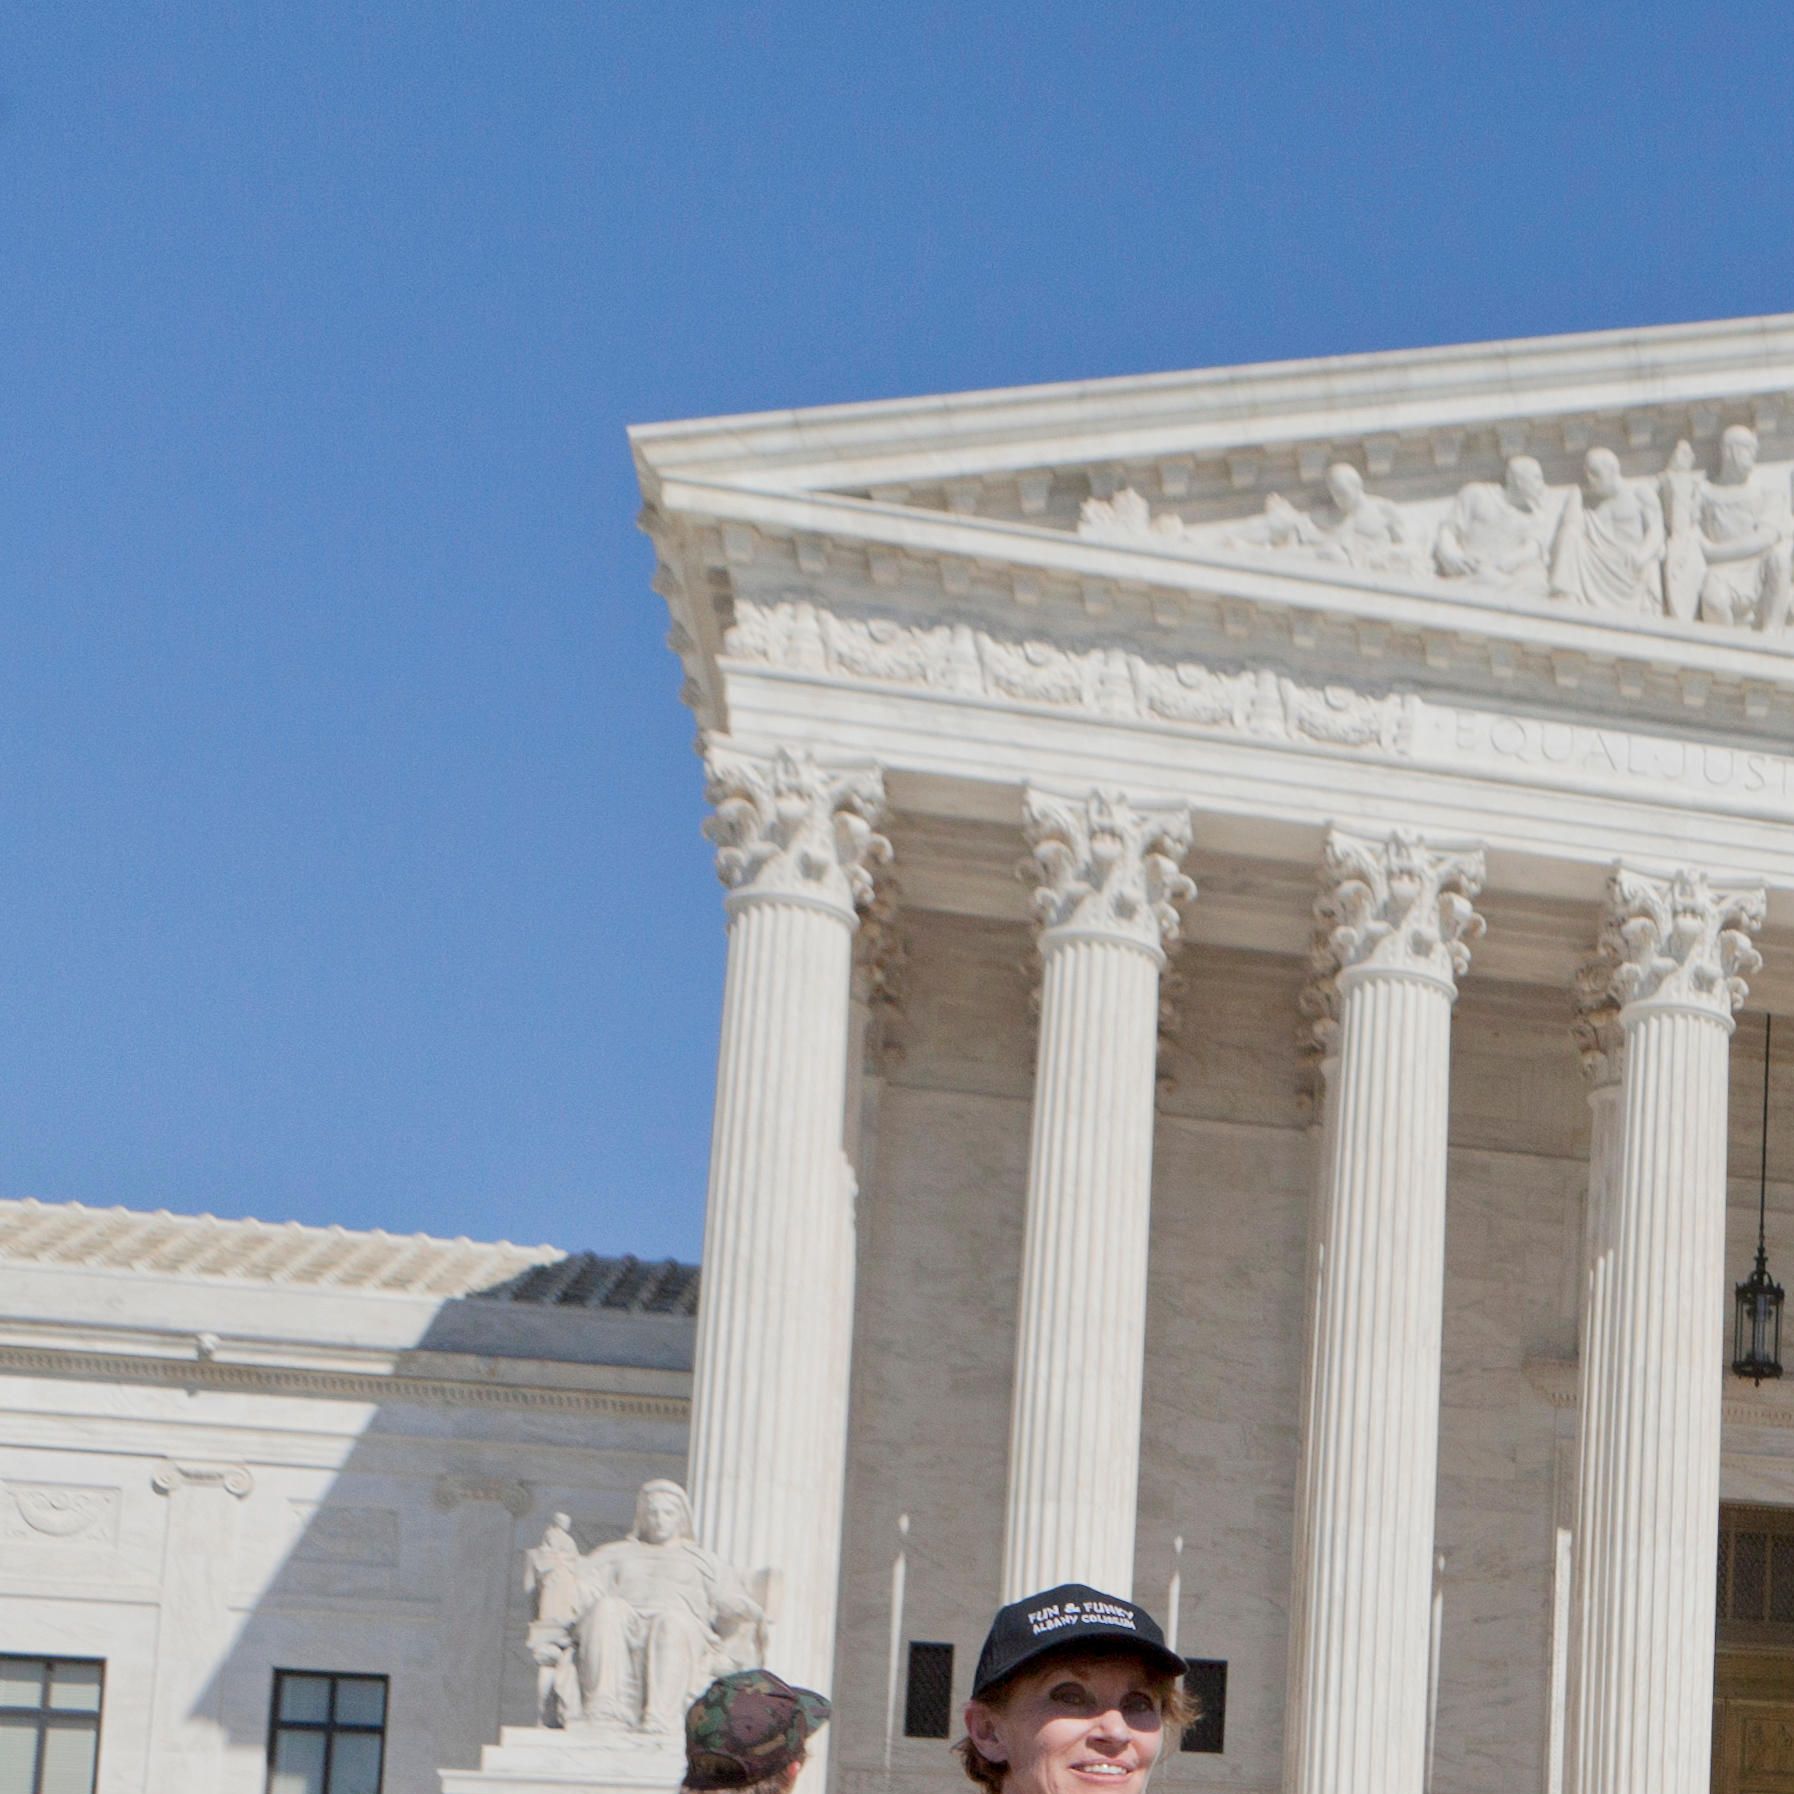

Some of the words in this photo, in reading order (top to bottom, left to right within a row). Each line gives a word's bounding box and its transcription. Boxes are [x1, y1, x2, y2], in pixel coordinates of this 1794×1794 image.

[1454, 712, 1649, 777] EQUAL
[1028, 1604, 1060, 1624] FUN
[1064, 1602, 1081, 1614] &
[1083, 1601, 1134, 1619] FUNKY
[1033, 1615, 1079, 1636] ALBANY
